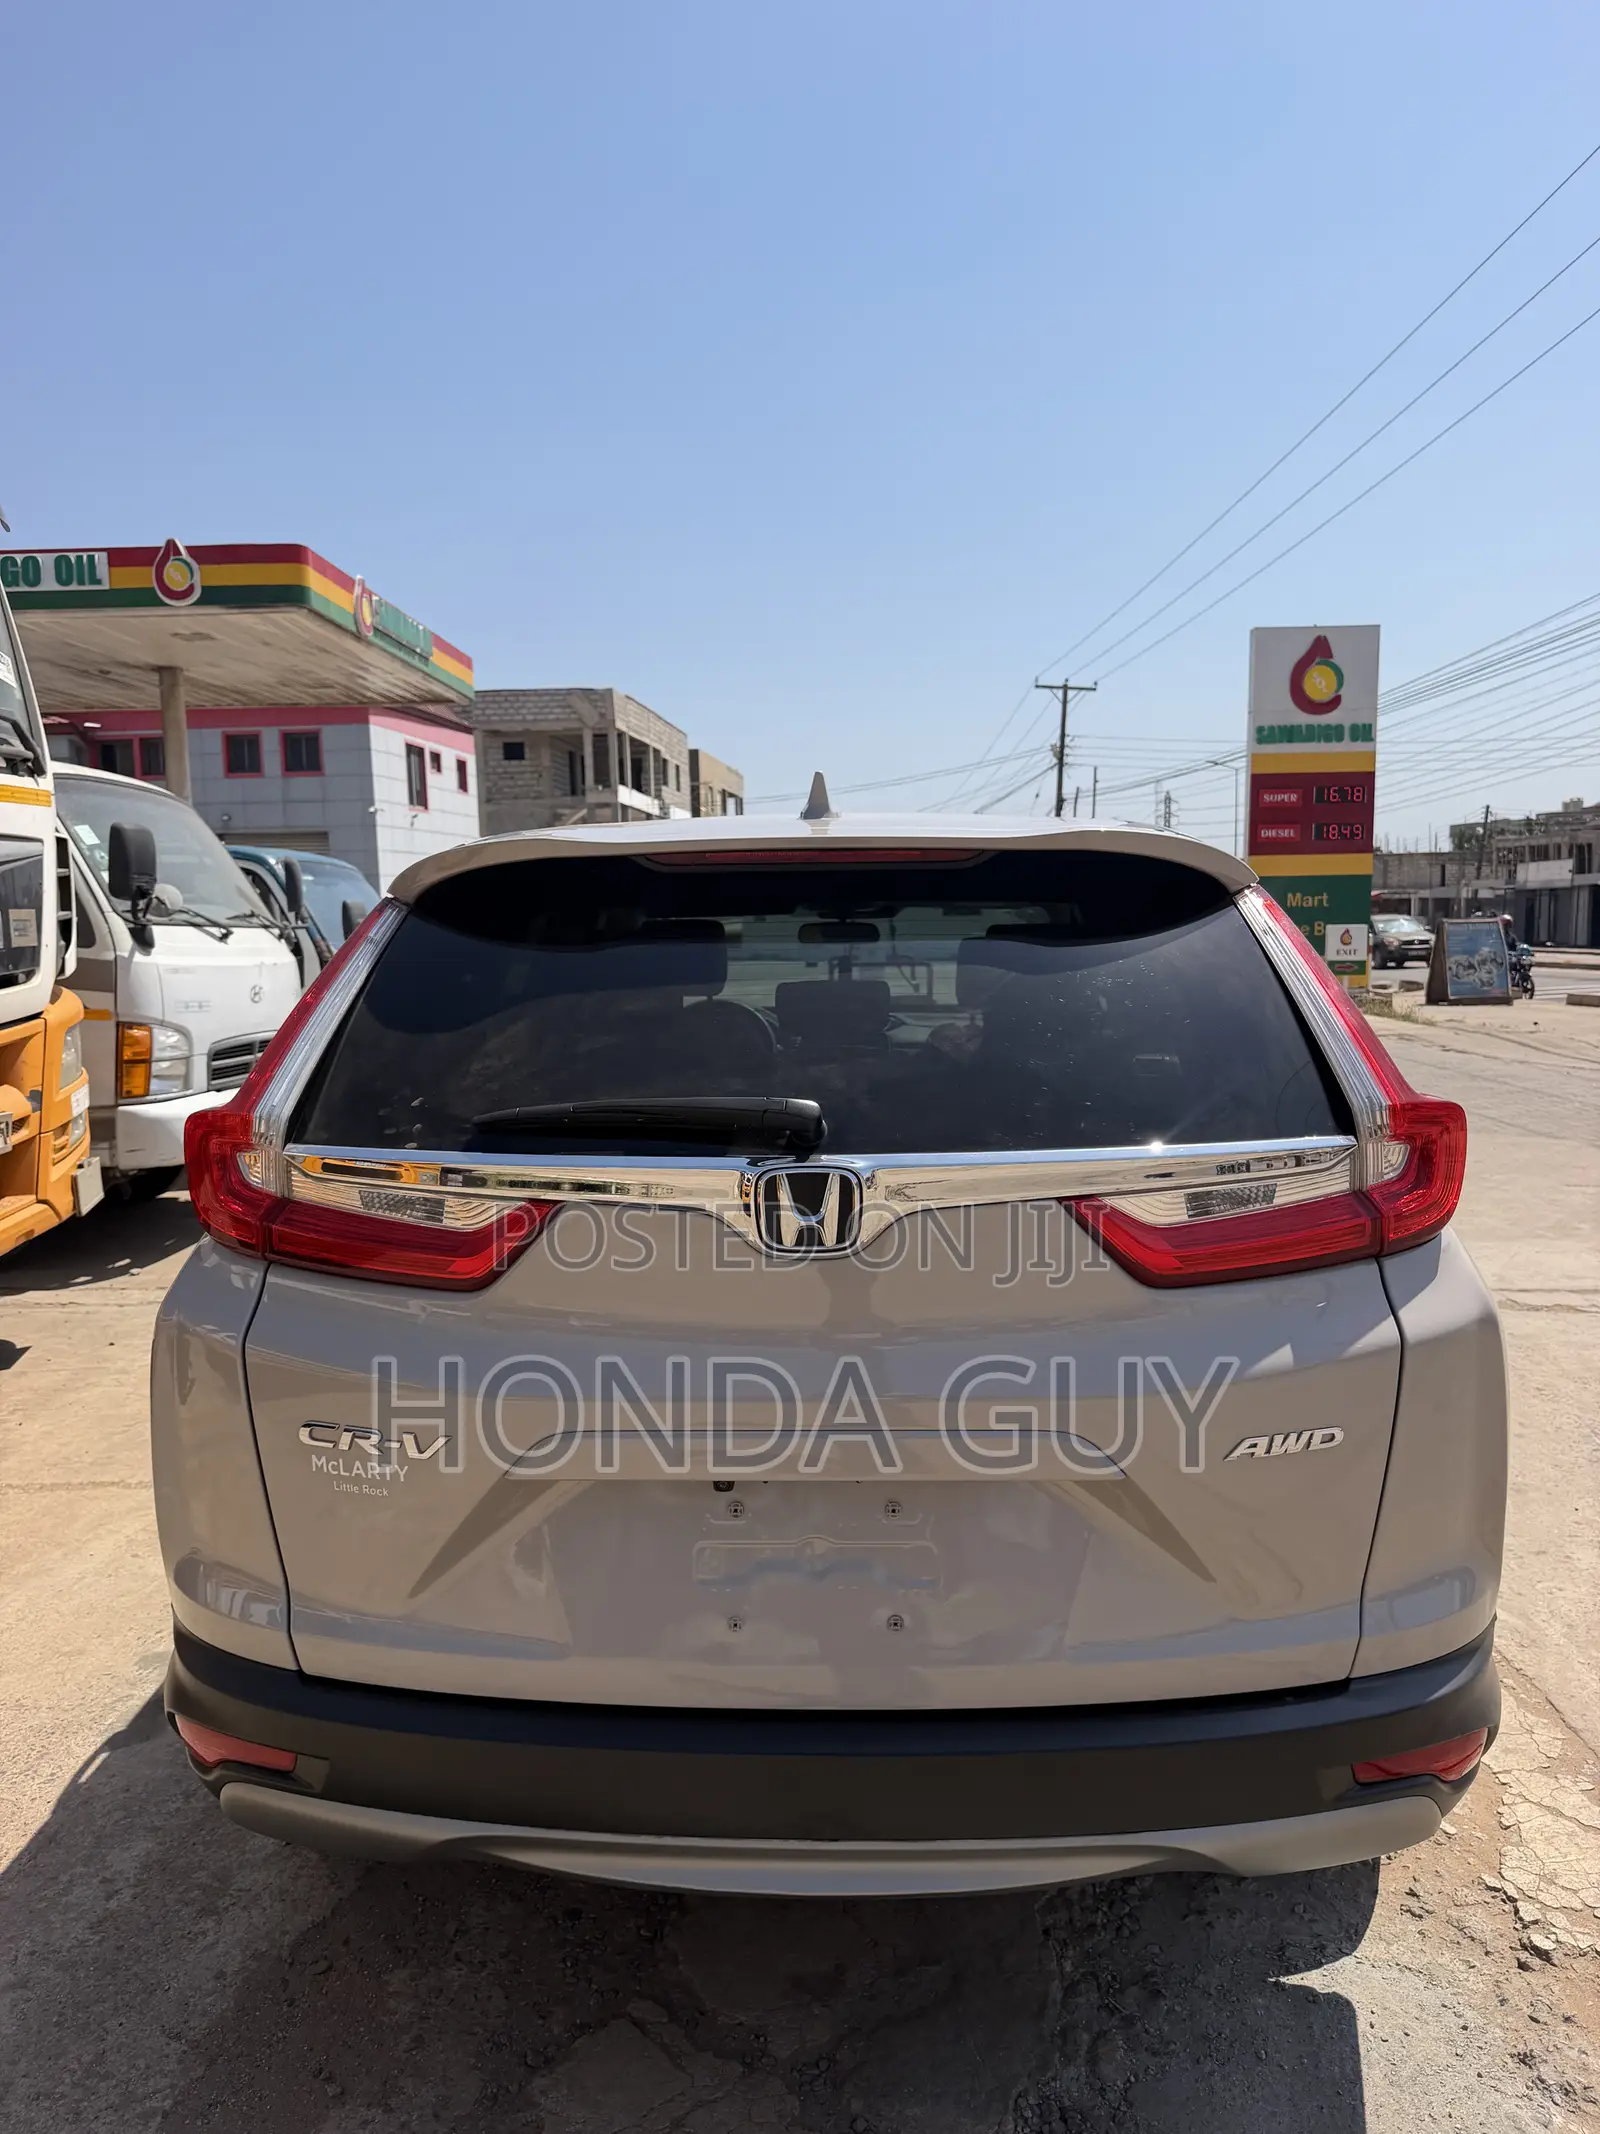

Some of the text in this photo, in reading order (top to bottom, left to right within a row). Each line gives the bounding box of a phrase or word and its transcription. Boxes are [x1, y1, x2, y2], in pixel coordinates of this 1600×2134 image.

[54, 555, 102, 586] OIL
[1349, 723, 1375, 742] OIL
[1263, 787, 1363, 803] SUPER 16.78
[1261, 824, 1362, 839] DIESEL 18.49
[1287, 892, 1329, 908] Mart
[1336, 948, 1359, 957] EXIT
[299, 1420, 452, 1460] CR-V
[1223, 1426, 1344, 1461] AWD
[312, 1454, 408, 1482] McLARTY
[333, 1481, 389, 1497] Little Rock
